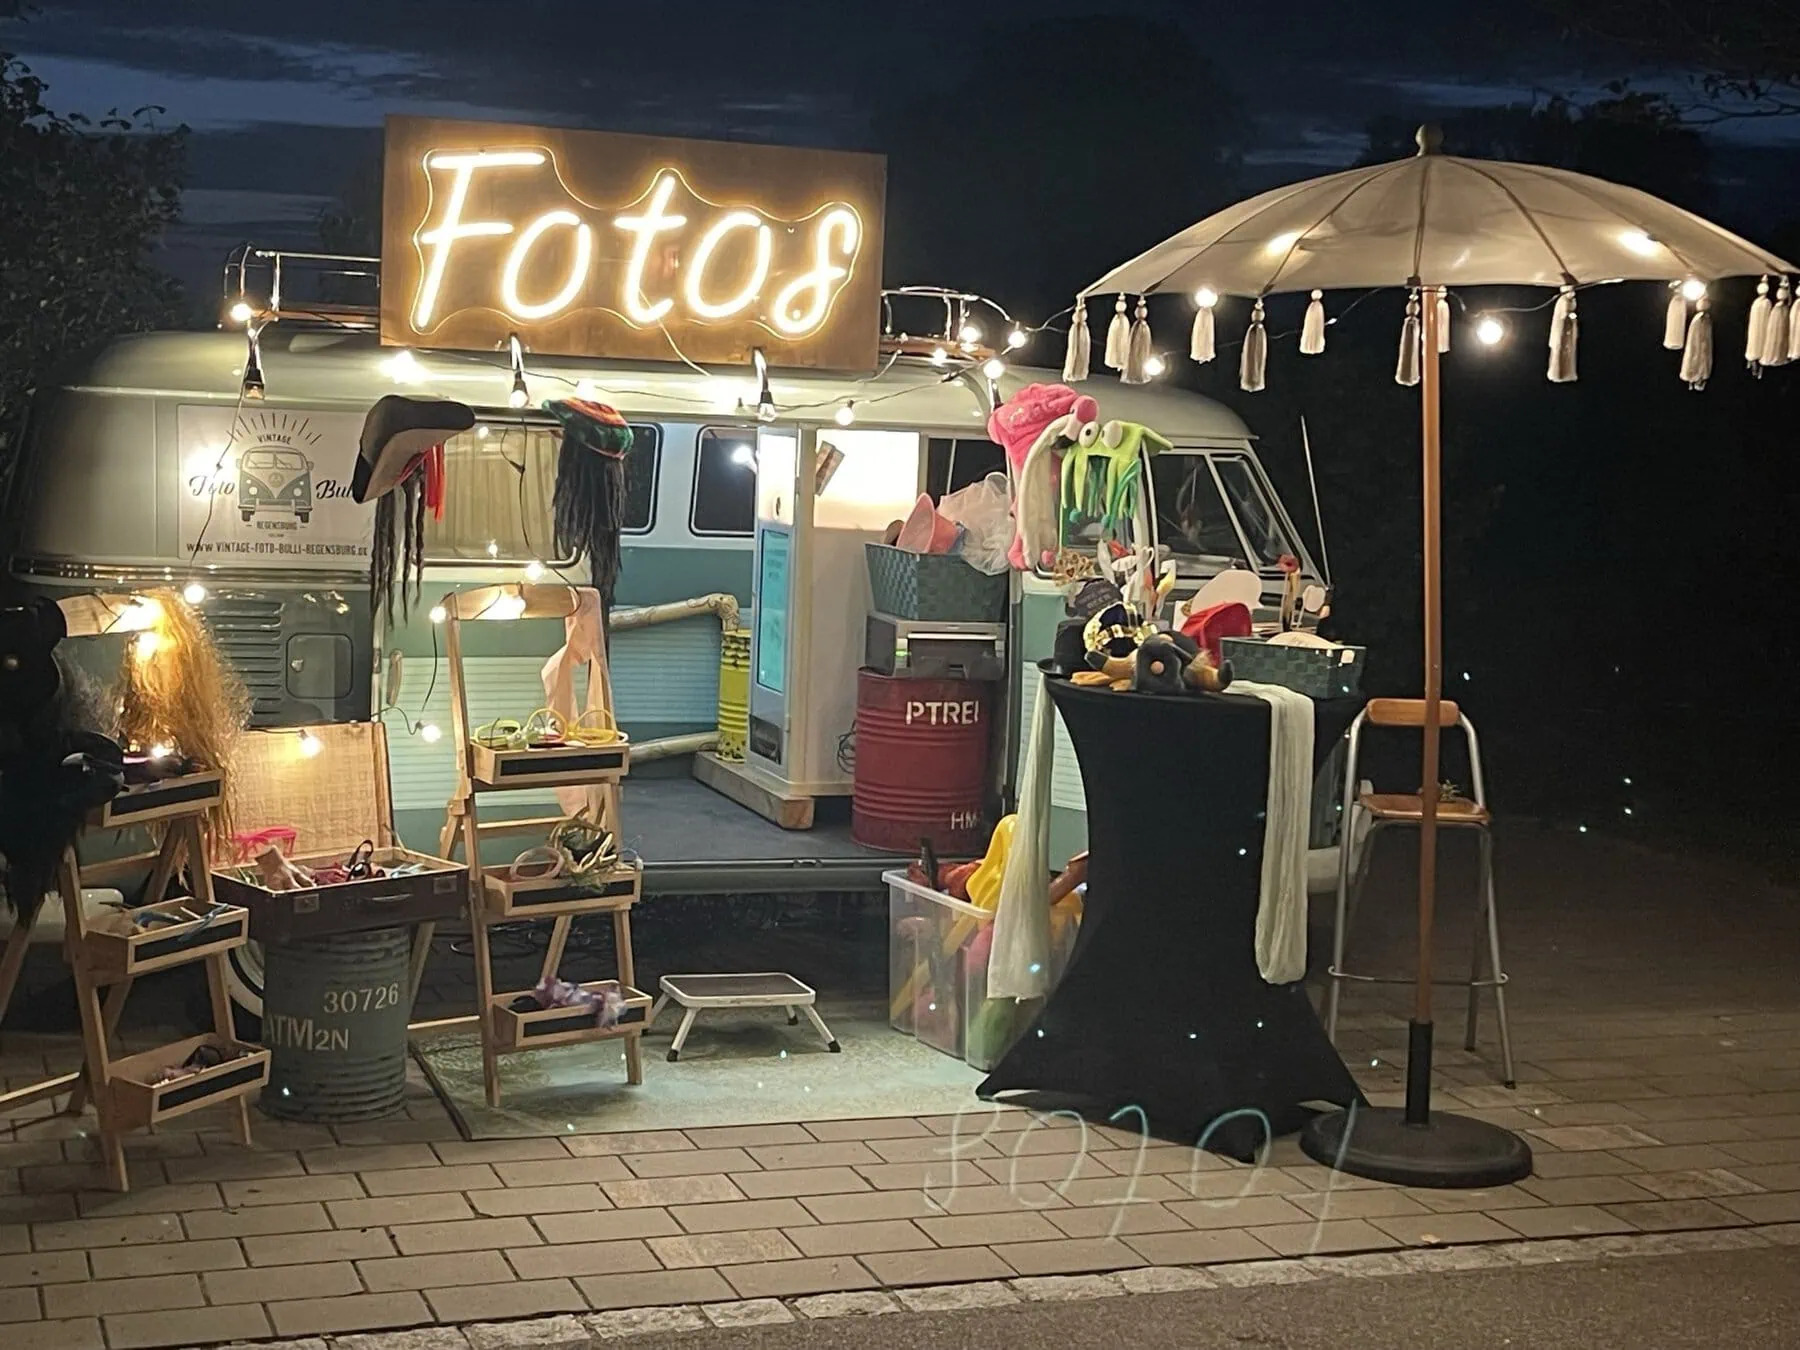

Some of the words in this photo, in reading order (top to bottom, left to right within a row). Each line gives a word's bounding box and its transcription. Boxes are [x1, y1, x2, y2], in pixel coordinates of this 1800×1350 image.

[416, 150, 860, 335] Fotos
[257, 433, 292, 445] VINTAGE
[315, 479, 352, 499] Bul
[323, 983, 400, 1013] 30726
